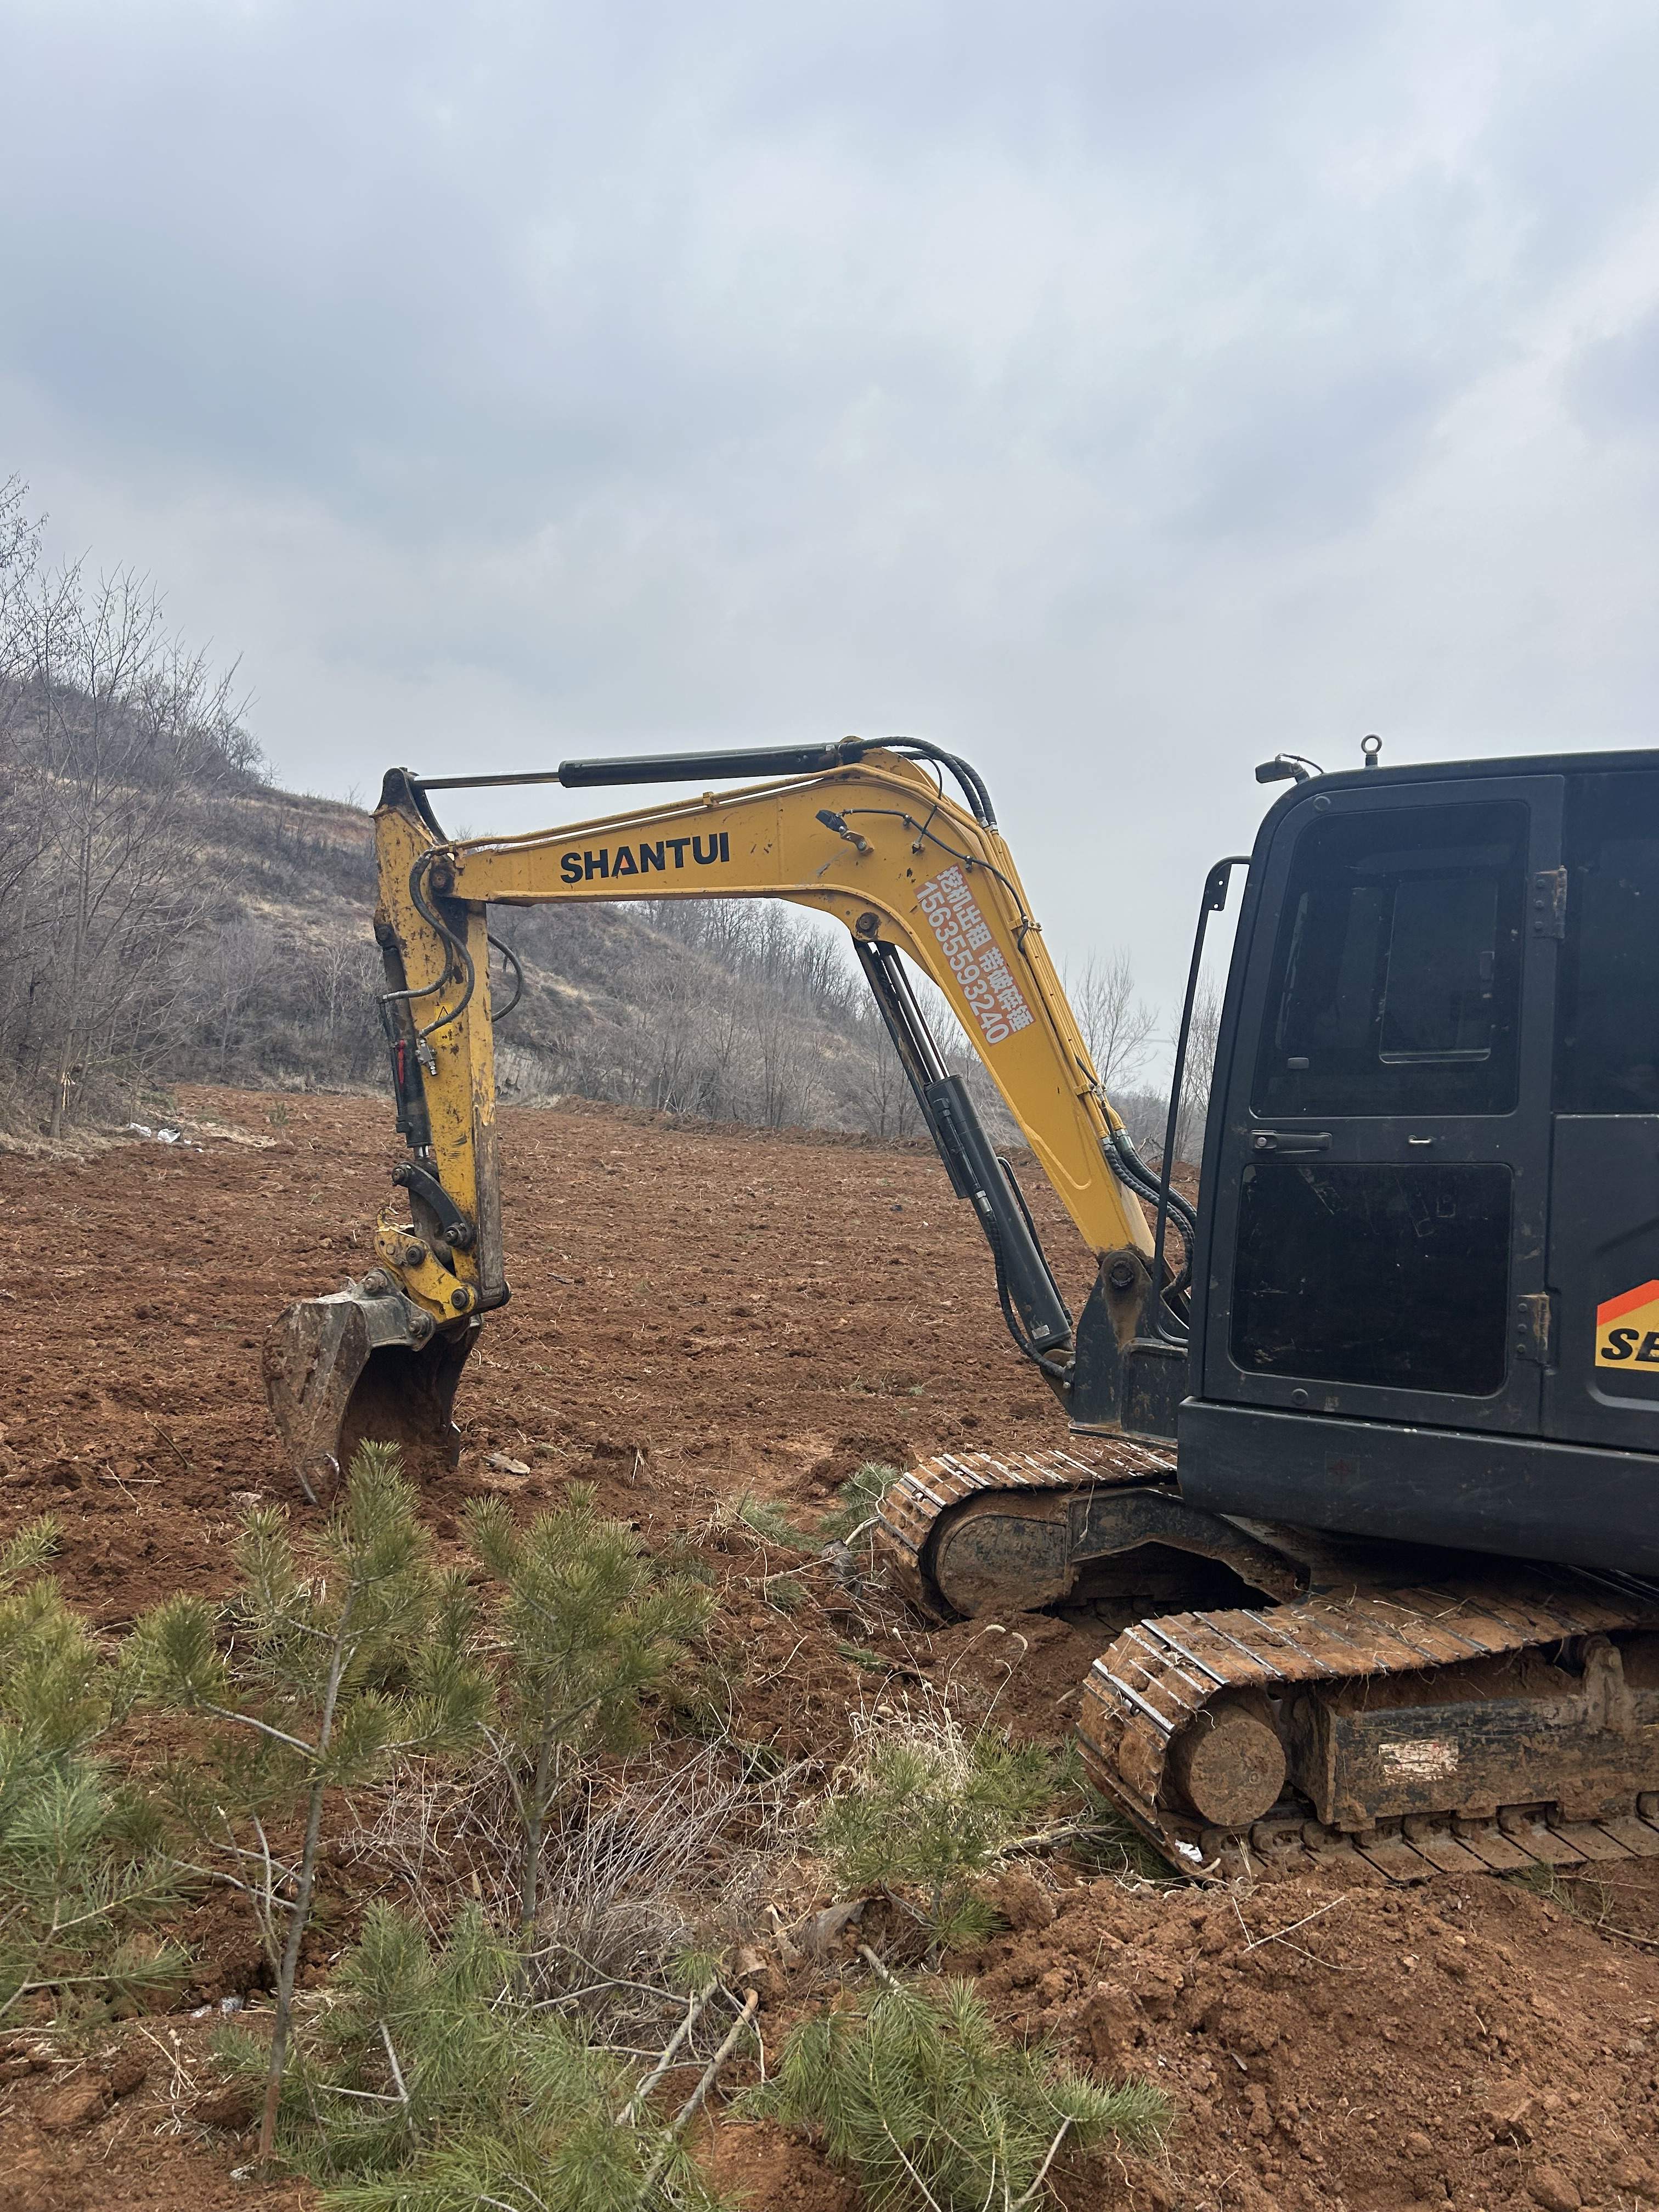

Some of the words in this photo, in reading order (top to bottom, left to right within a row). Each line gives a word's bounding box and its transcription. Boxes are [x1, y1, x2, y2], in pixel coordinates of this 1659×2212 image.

[560, 832, 730, 883] SHANTUI
[916, 881, 1009, 1043] 15635593240
[936, 866, 992, 951] 挖机出租
[978, 946, 1034, 1032] 带破碎锤
